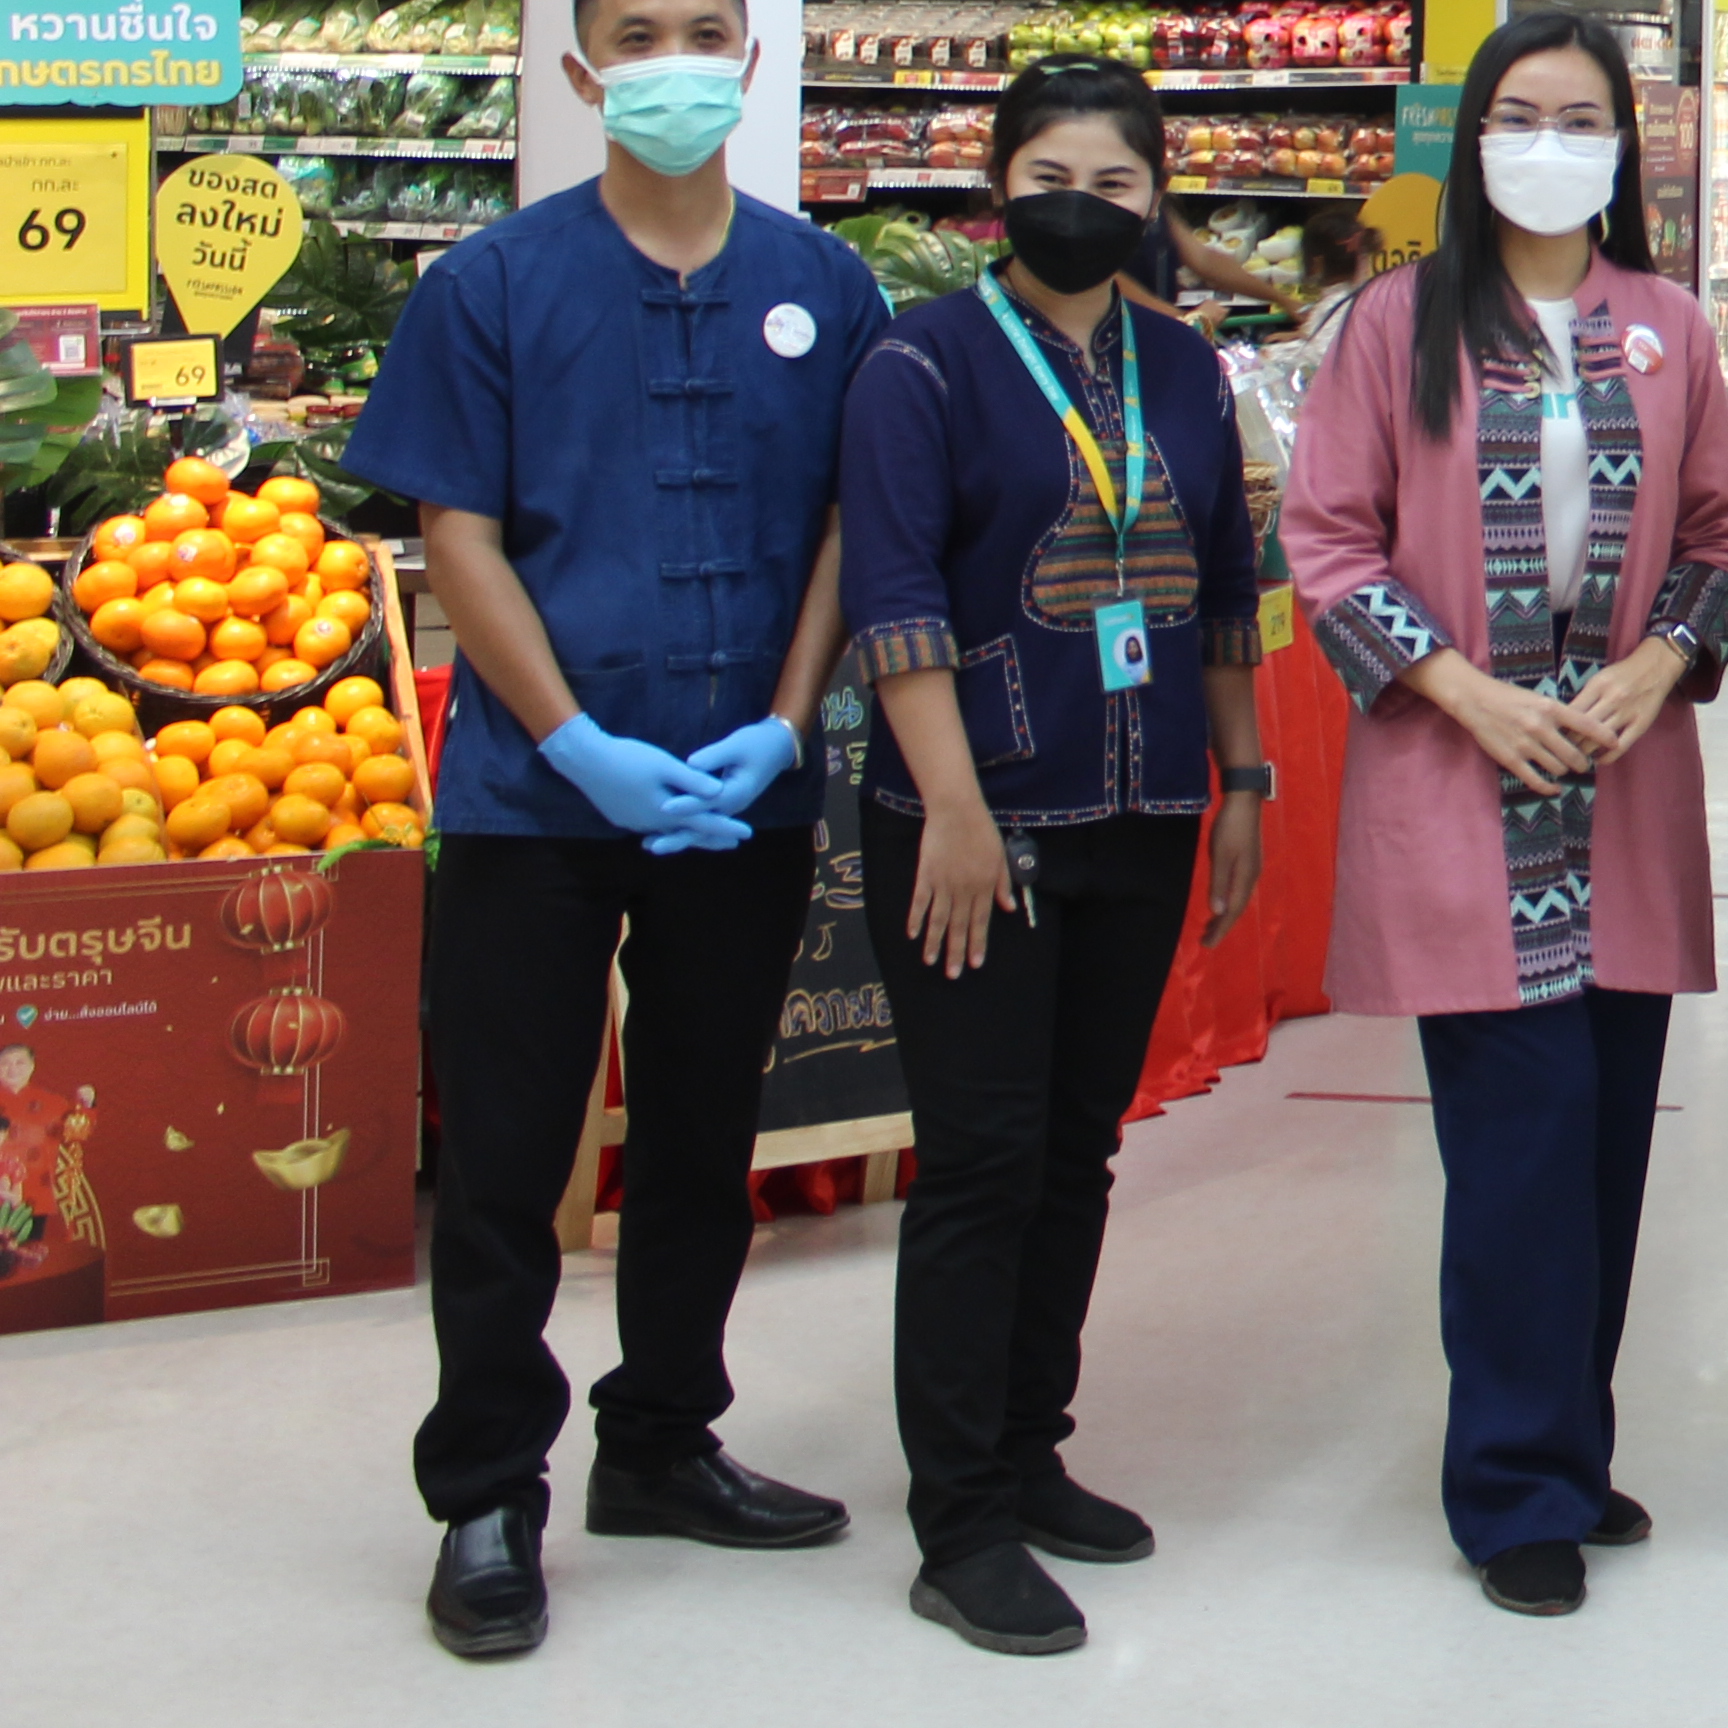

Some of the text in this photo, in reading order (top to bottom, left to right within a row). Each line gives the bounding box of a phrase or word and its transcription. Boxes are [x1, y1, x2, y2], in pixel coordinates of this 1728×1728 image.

[187, 168, 279, 201] ของสด
[18, 208, 87, 252] 69
[175, 199, 285, 239] ลงใหม่
[191, 238, 253, 273] วันนี้
[174, 365, 207, 388] 69
